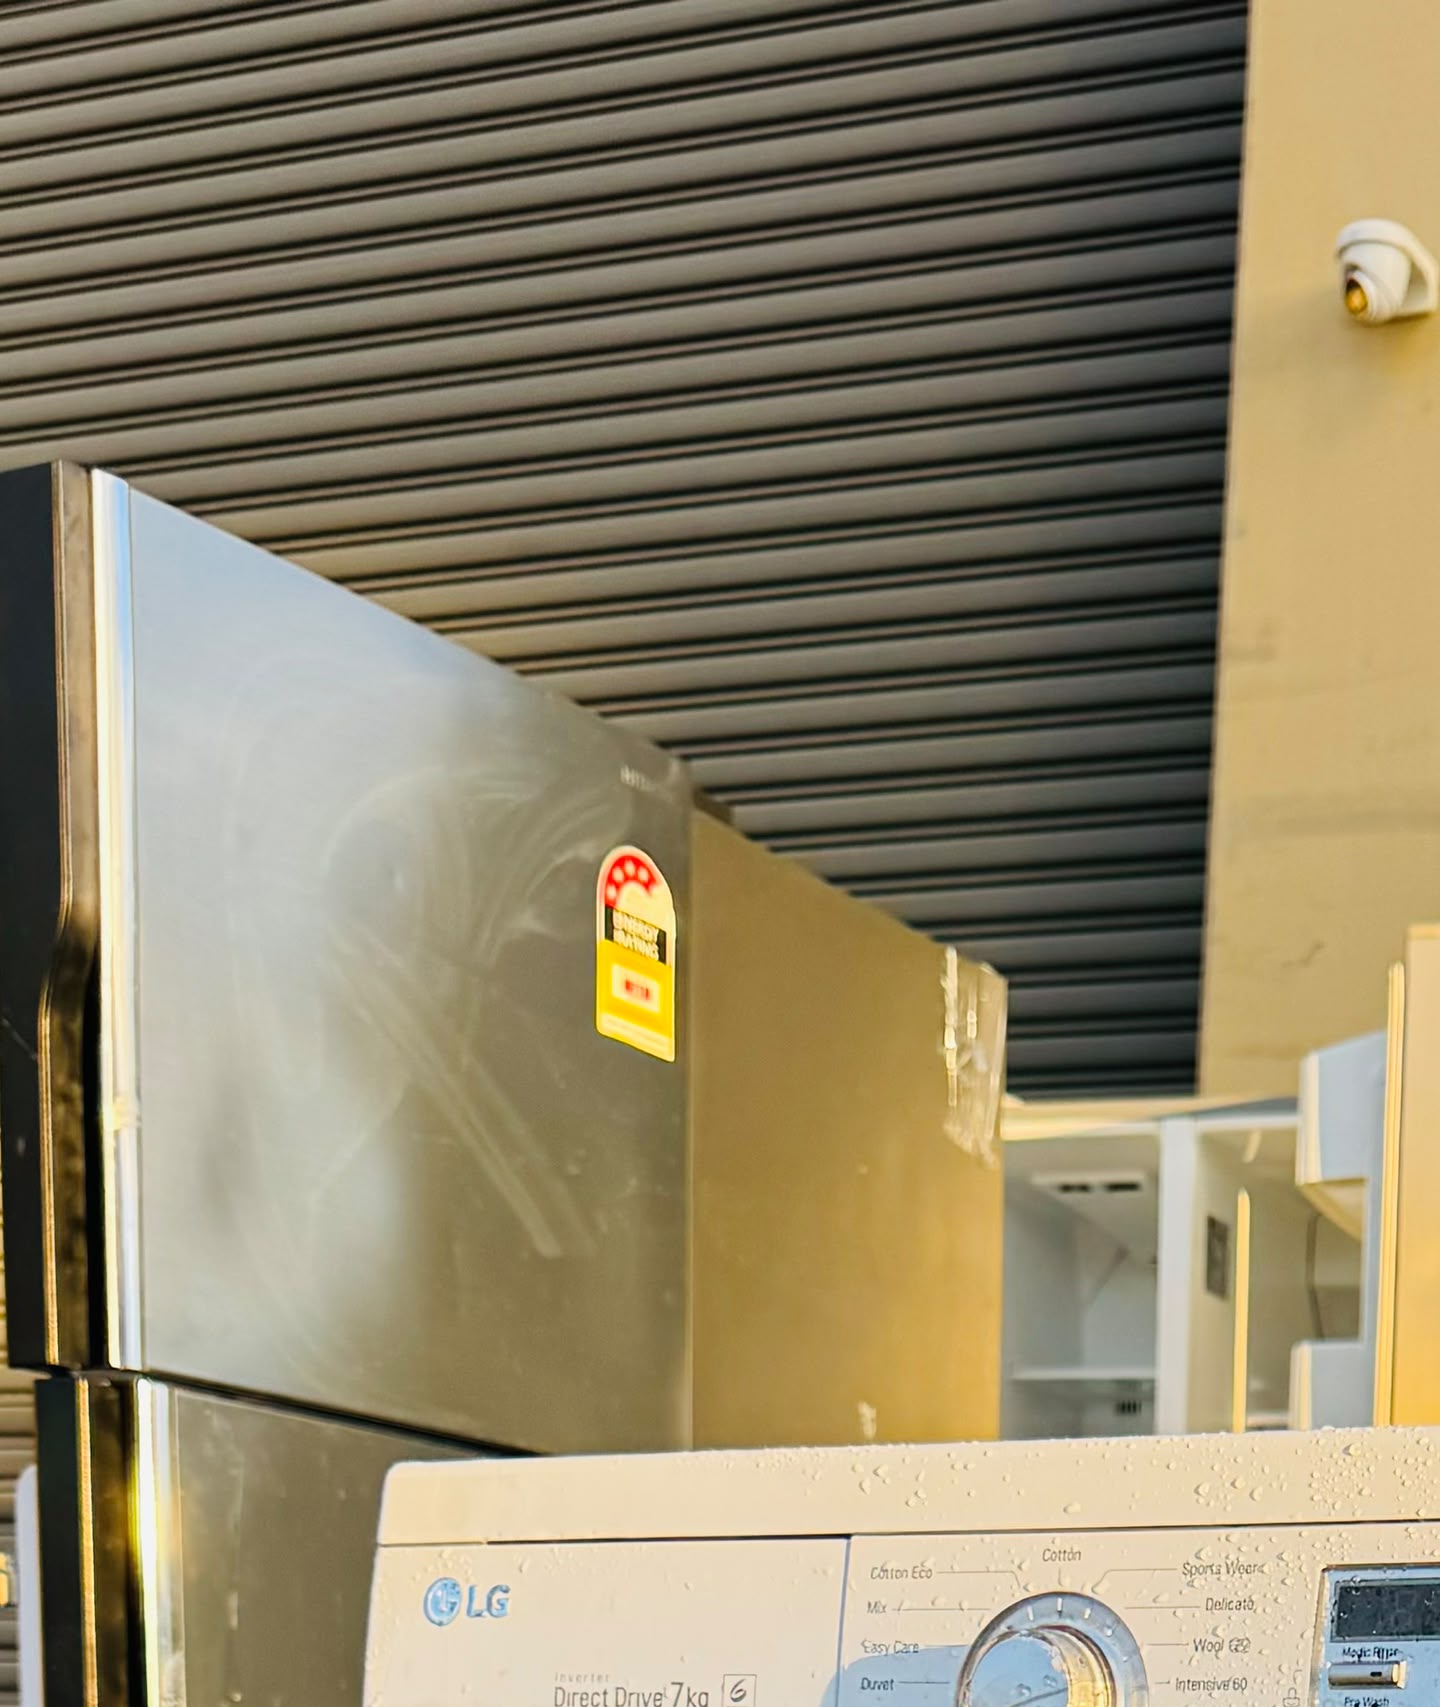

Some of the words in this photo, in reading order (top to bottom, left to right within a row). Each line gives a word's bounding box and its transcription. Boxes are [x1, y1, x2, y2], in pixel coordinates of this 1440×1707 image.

[1042, 1548, 1082, 1562] Cotton
[870, 1566, 908, 1580] Cotton
[911, 1566, 933, 1579] Eco
[1182, 1562, 1221, 1578] Sports
[466, 1584, 511, 1618] LG
[866, 1600, 887, 1614] Mix
[861, 1640, 890, 1656] Easy
[894, 1640, 919, 1654] Care
[1193, 1638, 1224, 1653] Wool
[860, 1677, 894, 1690] Duvet
[1175, 1677, 1229, 1691] Intensive
[1232, 1678, 1248, 1692] 60
